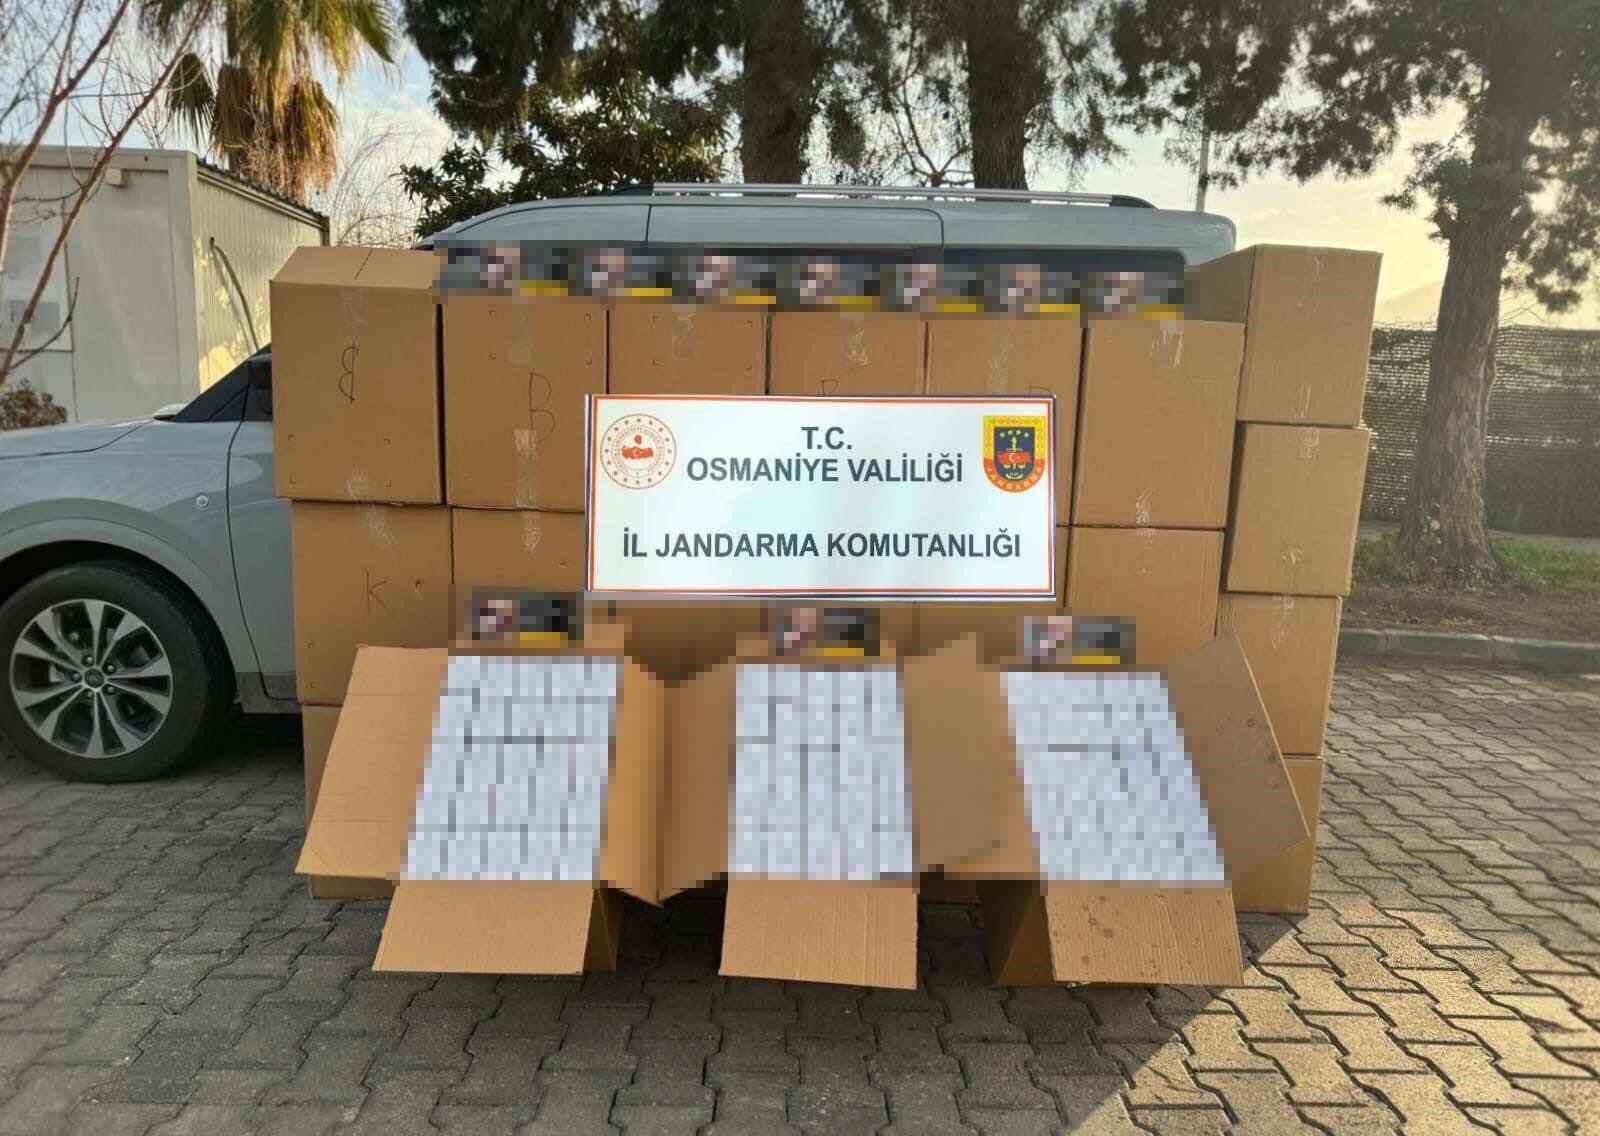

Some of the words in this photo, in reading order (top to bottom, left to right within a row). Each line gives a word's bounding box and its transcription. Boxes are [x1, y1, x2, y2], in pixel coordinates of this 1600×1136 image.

[526, 370, 556, 446] B
[800, 426, 852, 450] T.C.
[687, 452, 840, 482] OSMANİYE
[848, 452, 963, 482] VALİLİĞİ
[623, 527, 648, 558] İL
[655, 533, 820, 558] JANDARMA
[827, 527, 1020, 558] KOMUTANLIĞI
[363, 568, 400, 623] K
